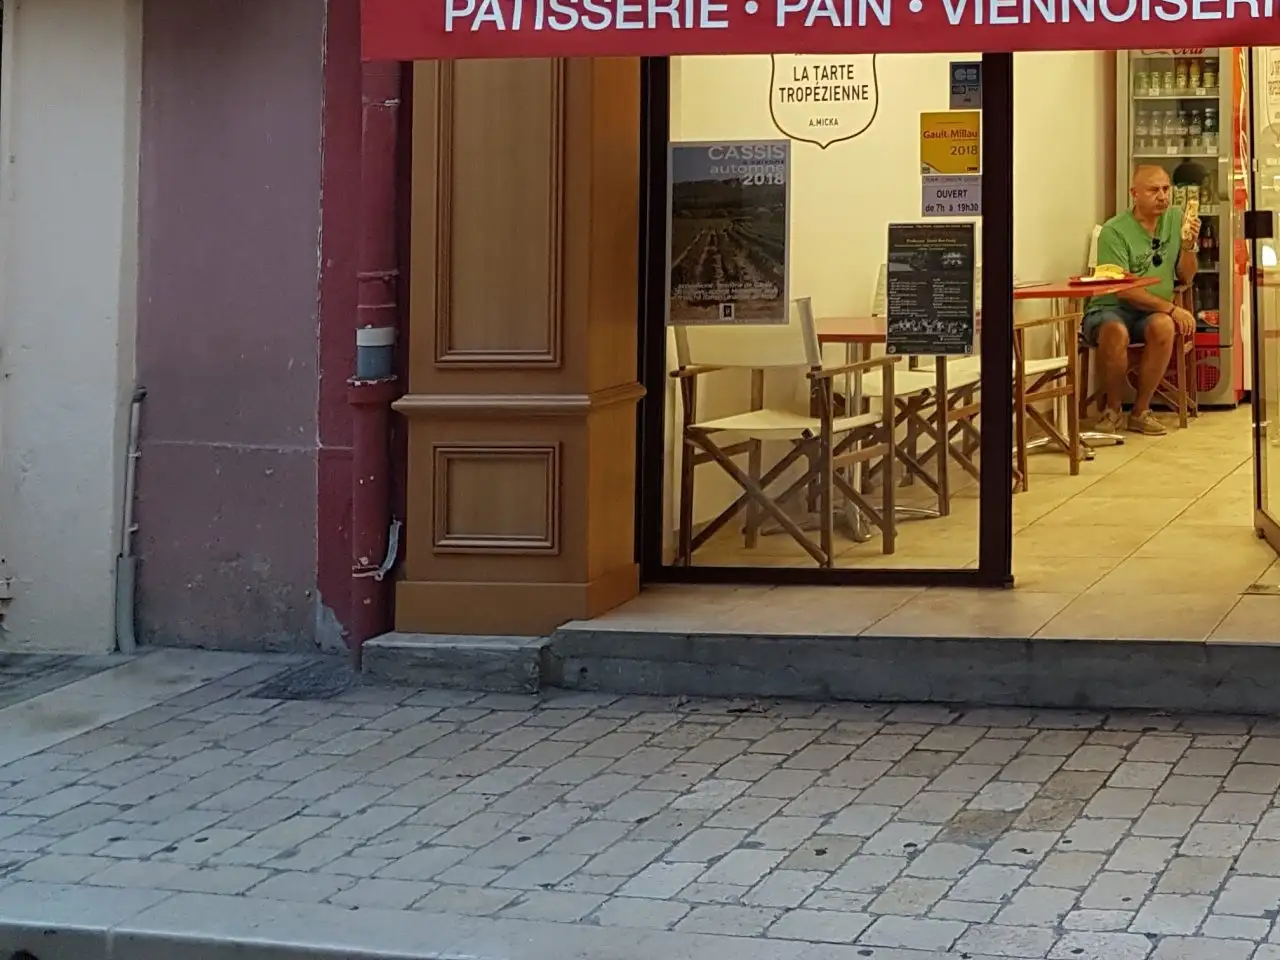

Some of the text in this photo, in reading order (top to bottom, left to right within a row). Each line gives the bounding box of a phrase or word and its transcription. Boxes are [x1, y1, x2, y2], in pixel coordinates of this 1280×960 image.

[793, 64, 855, 82] LA TARTE
[779, 81, 869, 103] TROPÉZIENNE
[808, 118, 839, 127] A.MICKA
[708, 144, 785, 160] CASSIS
[951, 145, 978, 156] 2018
[709, 163, 785, 175] automne
[742, 172, 785, 186] 2018
[936, 189, 968, 199] OUVERT
[957, 203, 979, 212] 19h30
